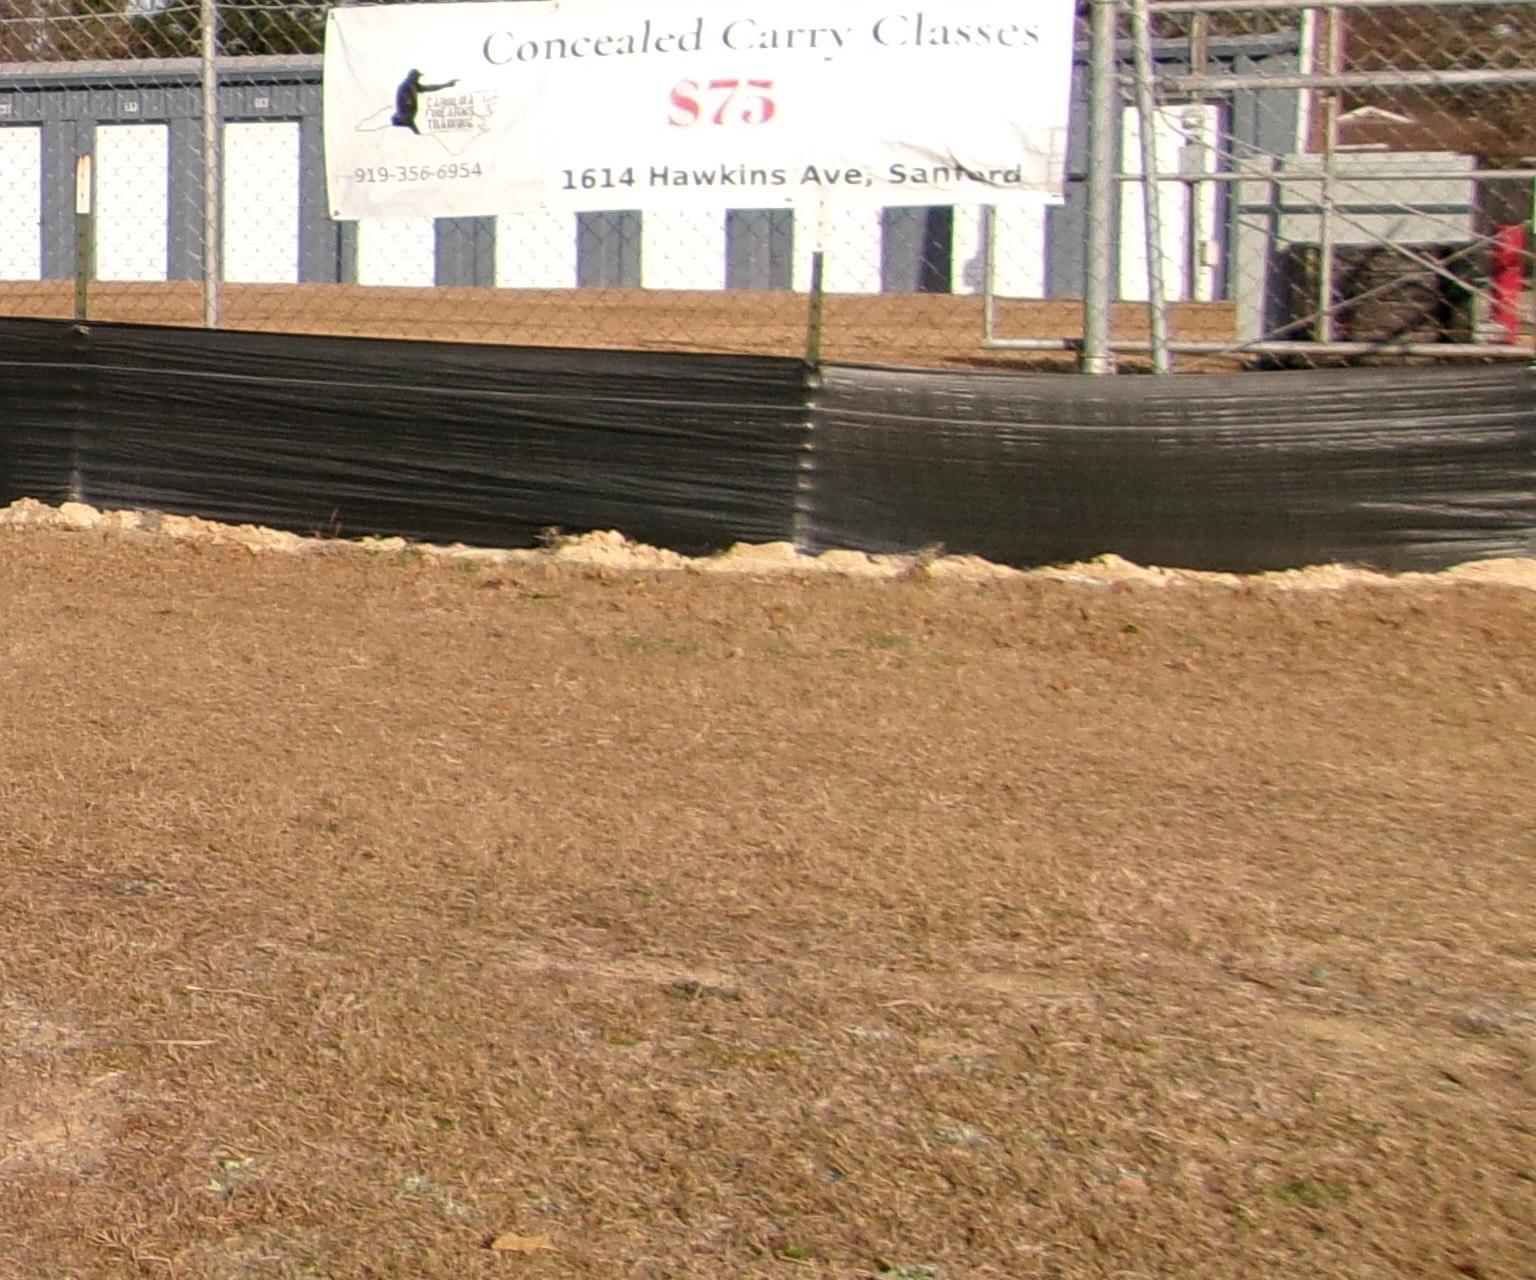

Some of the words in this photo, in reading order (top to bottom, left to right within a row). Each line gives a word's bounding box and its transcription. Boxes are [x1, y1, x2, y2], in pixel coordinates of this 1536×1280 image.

[483, 17, 703, 65] Concealed
[722, 18, 852, 61] Carry
[872, 12, 1039, 47] Classes
[668, 78, 775, 127] $75
[354, 163, 482, 183] 919-356-6954
[562, 167, 636, 190] 1614
[649, 164, 787, 187] Hawkins
[800, 165, 872, 187] Ave,
